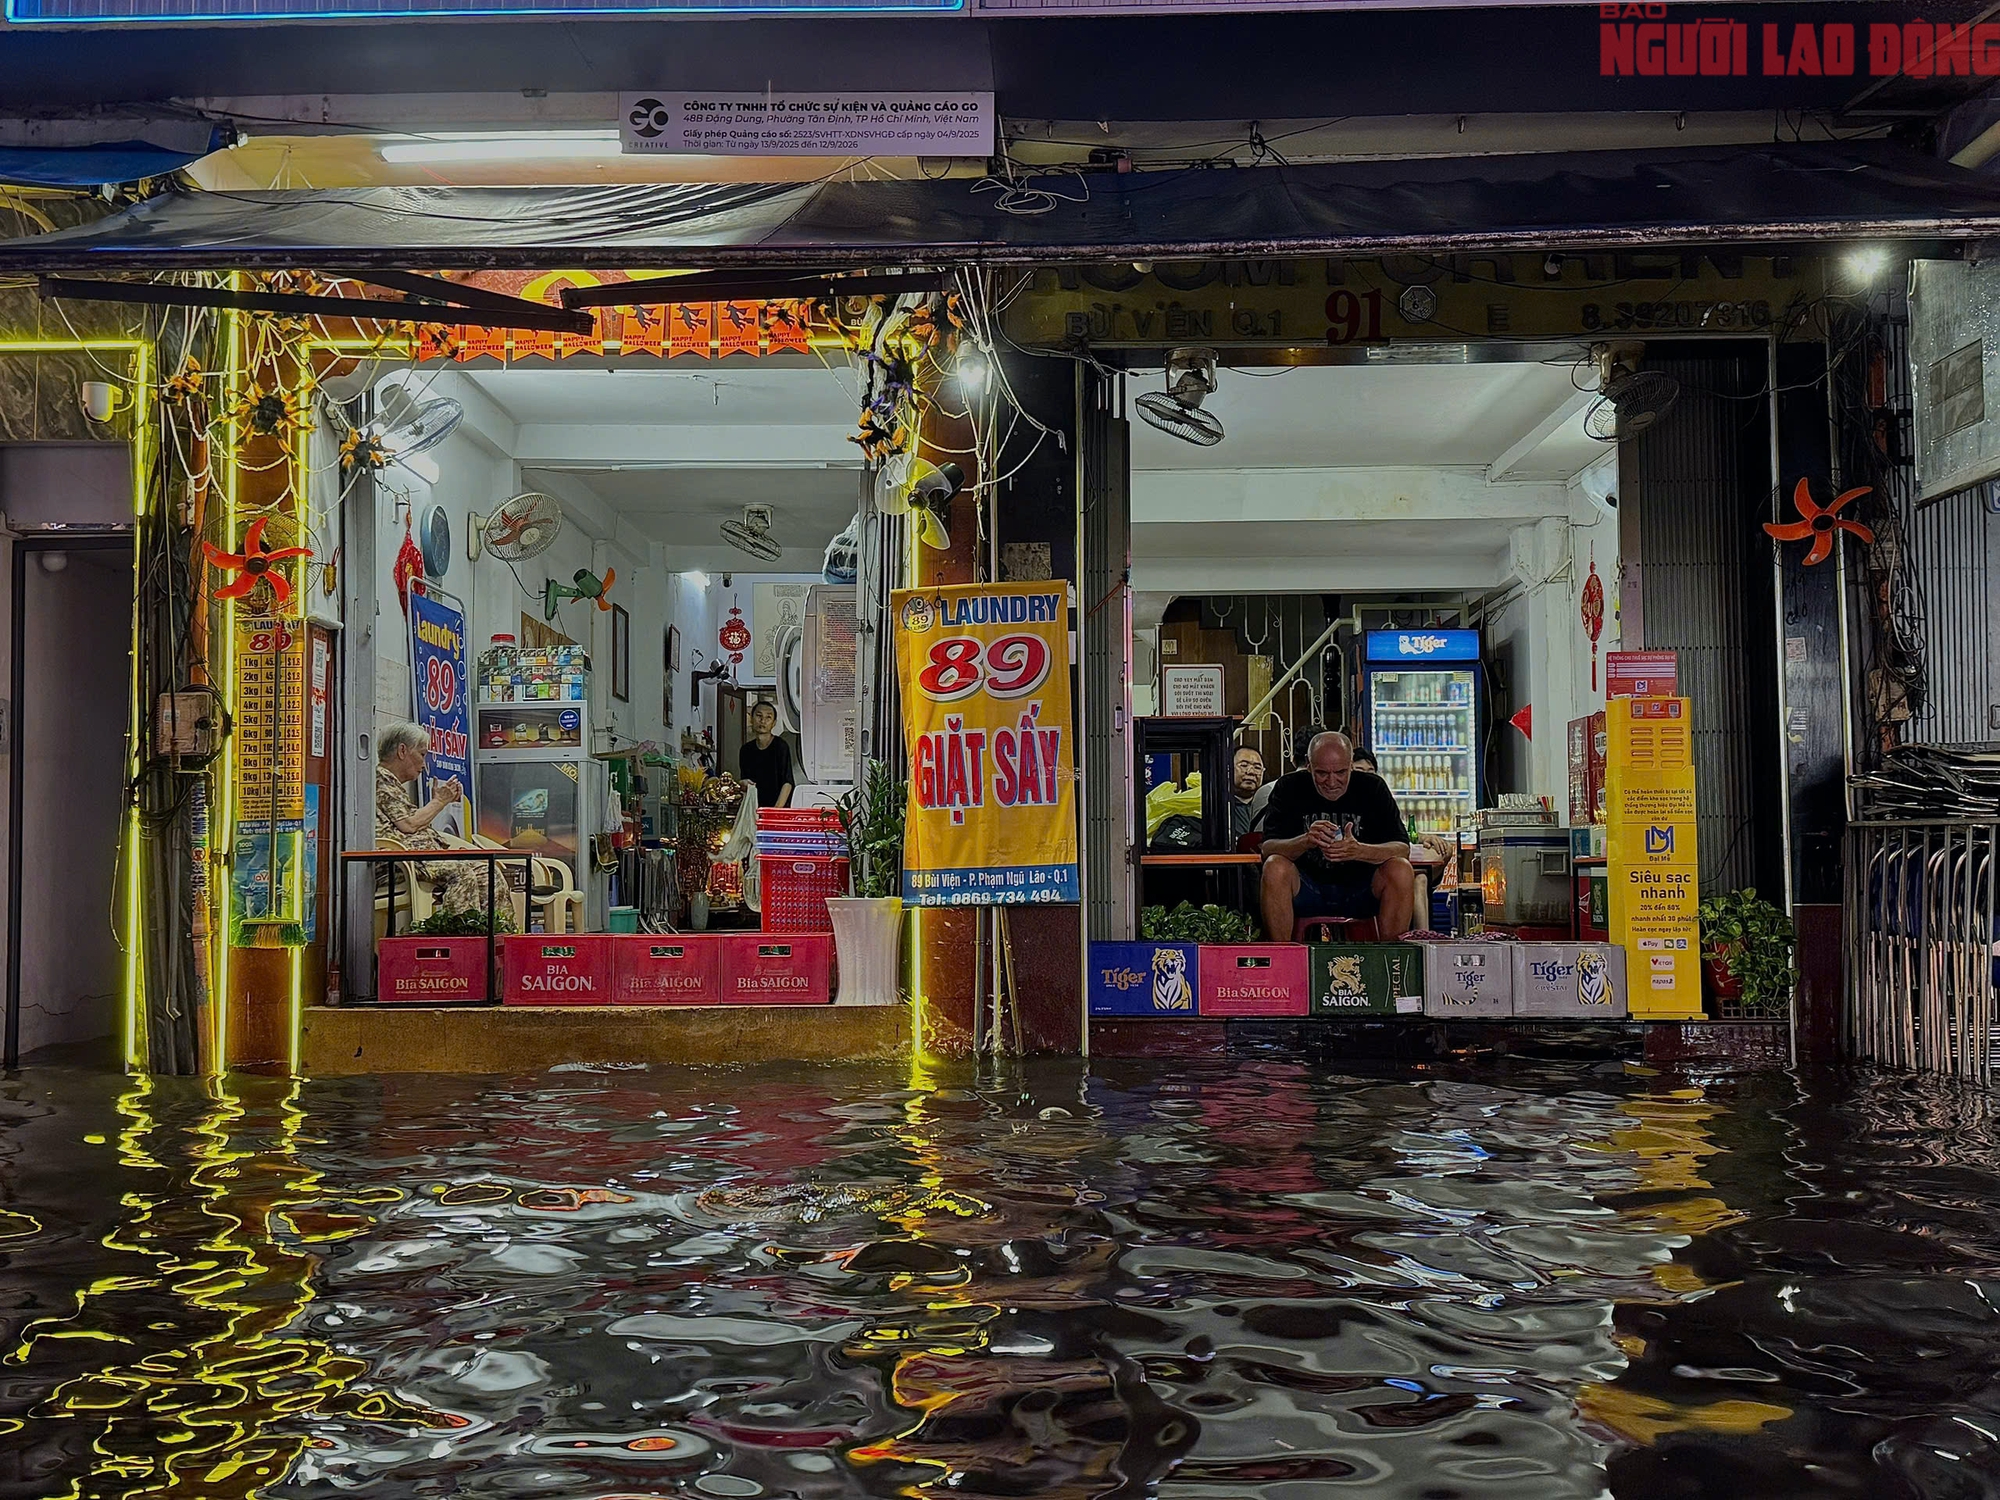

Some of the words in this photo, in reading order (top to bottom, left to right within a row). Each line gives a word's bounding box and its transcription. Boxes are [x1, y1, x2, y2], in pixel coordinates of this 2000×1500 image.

[683, 100, 716, 112] CÔNG
[719, 103, 733, 111] TY
[735, 103, 767, 112] TNHH
[770, 99, 786, 112] TỔ
[788, 100, 821, 112] CHỨC
[823, 98, 839, 114] SỰ
[841, 100, 868, 114] KIỆN
[871, 100, 887, 112] VÀ
[890, 99, 931, 112] QUẢNG
[934, 100, 959, 112] CÁO
[961, 103, 979, 112] GO
[683, 114, 703, 123] 48B
[735, 115, 764, 124] Dung,
[767, 114, 805, 125] Phường
[808, 114, 825, 123] Tân
[827, 114, 853, 125] Định,
[856, 115, 869, 123] TP
[870, 113, 885, 123] Hồ
[886, 113, 904, 123] Chí
[904, 114, 931, 124] Minh,
[934, 113, 953, 124] Việt
[955, 115, 979, 123] Nam
[683, 130, 702, 140] Giấy
[704, 130, 727, 141] phép
[729, 130, 759, 141] Quảng
[761, 130, 777, 139] cáo
[779, 129, 792, 139] số:
[897, 130, 913, 141] cấp
[914, 131, 935, 140] ngày
[937, 130, 979, 140] 04/9/2025
[683, 139, 701, 149] Thời
[703, 139, 724, 150] gian:
[726, 139, 737, 149] Từ
[738, 140, 760, 150] ngày
[761, 140, 800, 149] 13/9/2025
[801, 139, 817, 149] đến
[819, 140, 859, 149] 12/9/2026
[1324, 287, 1391, 346] 91
[940, 593, 1060, 626] LAUNDRY
[1411, 635, 1448, 653] Tiger
[244, 658, 258, 667] 1kg
[919, 636, 1046, 698] 89
[244, 672, 259, 681] 2kg
[244, 687, 259, 695] 3kg
[427, 656, 455, 714] 89
[244, 701, 258, 710] 4kg
[244, 715, 258, 724] 5kg
[244, 730, 258, 738] 6kg
[445, 716, 467, 760] SẤY
[243, 744, 258, 753] 7kg
[243, 758, 258, 767] 8kg
[914, 716, 986, 824] GIẶT
[994, 702, 1061, 806] SẤY
[243, 773, 258, 781] 9kg
[243, 787, 259, 796] 10kg
[912, 875, 923, 888] 89
[925, 873, 939, 888] Bùi
[941, 873, 961, 890] Viện
[969, 872, 977, 886] P.
[979, 872, 1004, 889] Phạm
[1006, 871, 1025, 886] Ngũ
[1030, 870, 1045, 885] Lão
[1053, 869, 1068, 884] Q.1
[1630, 869, 1661, 883] Siêu
[1666, 873, 1691, 887] sạc
[919, 893, 946, 906] Tel:
[996, 891, 1026, 903] 734
[1031, 889, 1062, 902] 494
[1641, 886, 1686, 899] nhanh
[1654, 903, 1665, 911] đến
[1653, 914, 1666, 922] nhất
[1648, 940, 1658, 948] Pay
[547, 965, 568, 975] BIA
[1530, 960, 1574, 982] Tiger
[396, 979, 417, 990] Bia
[419, 977, 468, 989] SAIGON
[630, 977, 652, 989] Bia
[737, 977, 758, 989] Bia
[760, 977, 809, 988] SAIGON
[1101, 967, 1147, 991] Tiger
[1455, 970, 1485, 988] Tiger
[1217, 987, 1239, 998] Bia
[1240, 987, 1290, 998] SAIGON
[1535, 984, 1568, 992] CRYSTAL
